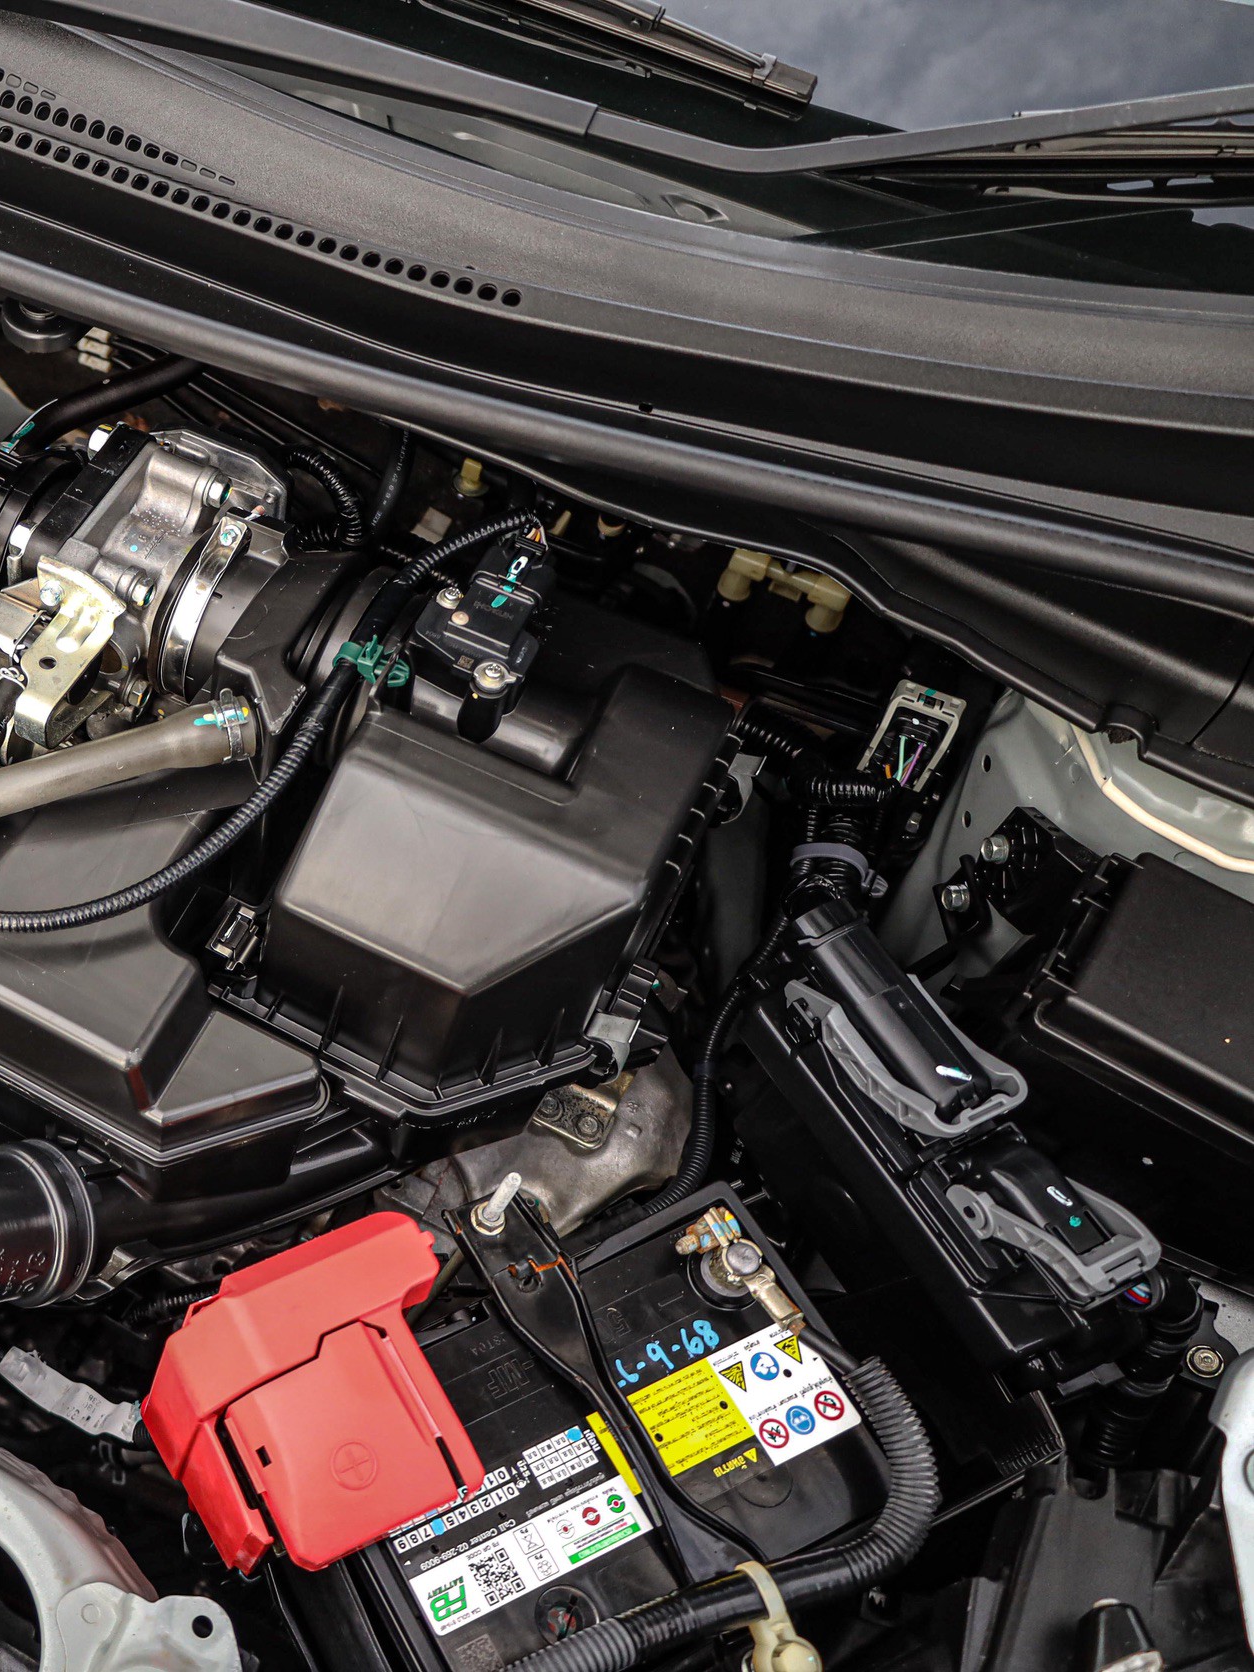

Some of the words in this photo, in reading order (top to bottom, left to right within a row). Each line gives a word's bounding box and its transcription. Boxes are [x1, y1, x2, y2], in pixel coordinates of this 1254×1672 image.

[712, 1454, 748, 1478] อันตราย
[495, 1468, 506, 1480] 0
[505, 1485, 515, 1496] 0
[481, 1497, 491, 1508] 2
[469, 1503, 479, 1514] 3
[457, 1509, 467, 1520] 4
[445, 1515, 455, 1526] 5
[498, 1518, 517, 1532] Call
[421, 1527, 430, 1537] 7
[469, 1528, 498, 1546] Center
[396, 1538, 407, 1549] 9
[408, 1532, 418, 1544] 8
[480, 1544, 491, 1553] QR
[419, 1542, 470, 1571] 02-269-9009
[465, 1549, 481, 1561] CODE
[427, 1576, 465, 1599] BATTERY
[428, 1583, 469, 1622] FB
[456, 1611, 471, 1622] GOLD
